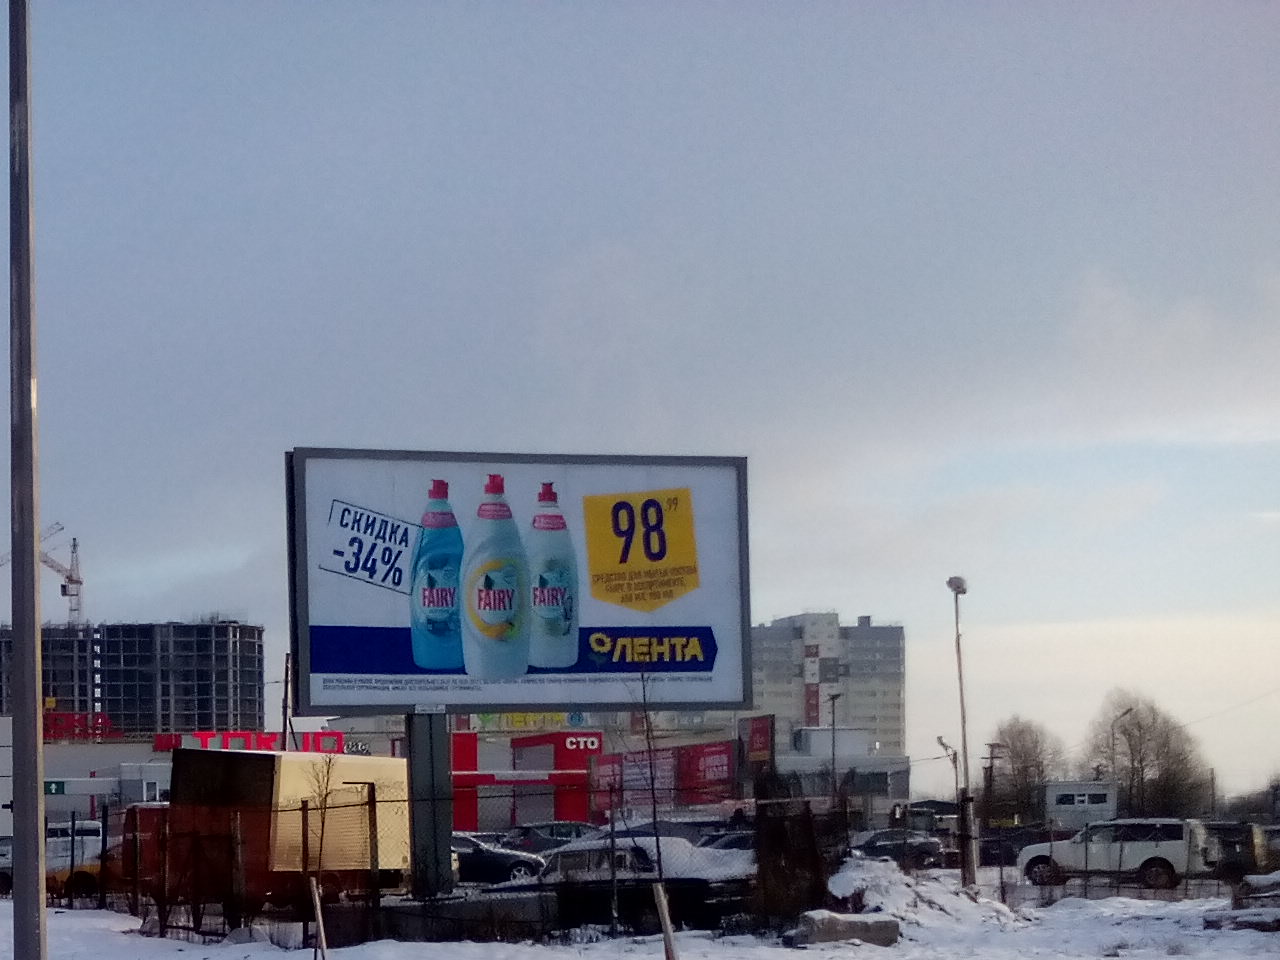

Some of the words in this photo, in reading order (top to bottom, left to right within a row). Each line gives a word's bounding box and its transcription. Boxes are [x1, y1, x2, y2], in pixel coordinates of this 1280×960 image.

[340, 507, 408, 548] СКИДКА
[611, 498, 667, 564] 98
[332, 536, 402, 586] -34%
[422, 586, 456, 608] FAIRY
[478, 588, 515, 610] FAIRY
[532, 586, 566, 606] FAIRY
[612, 636, 704, 662] ЛЕНТА
[566, 737, 598, 750] СТО
